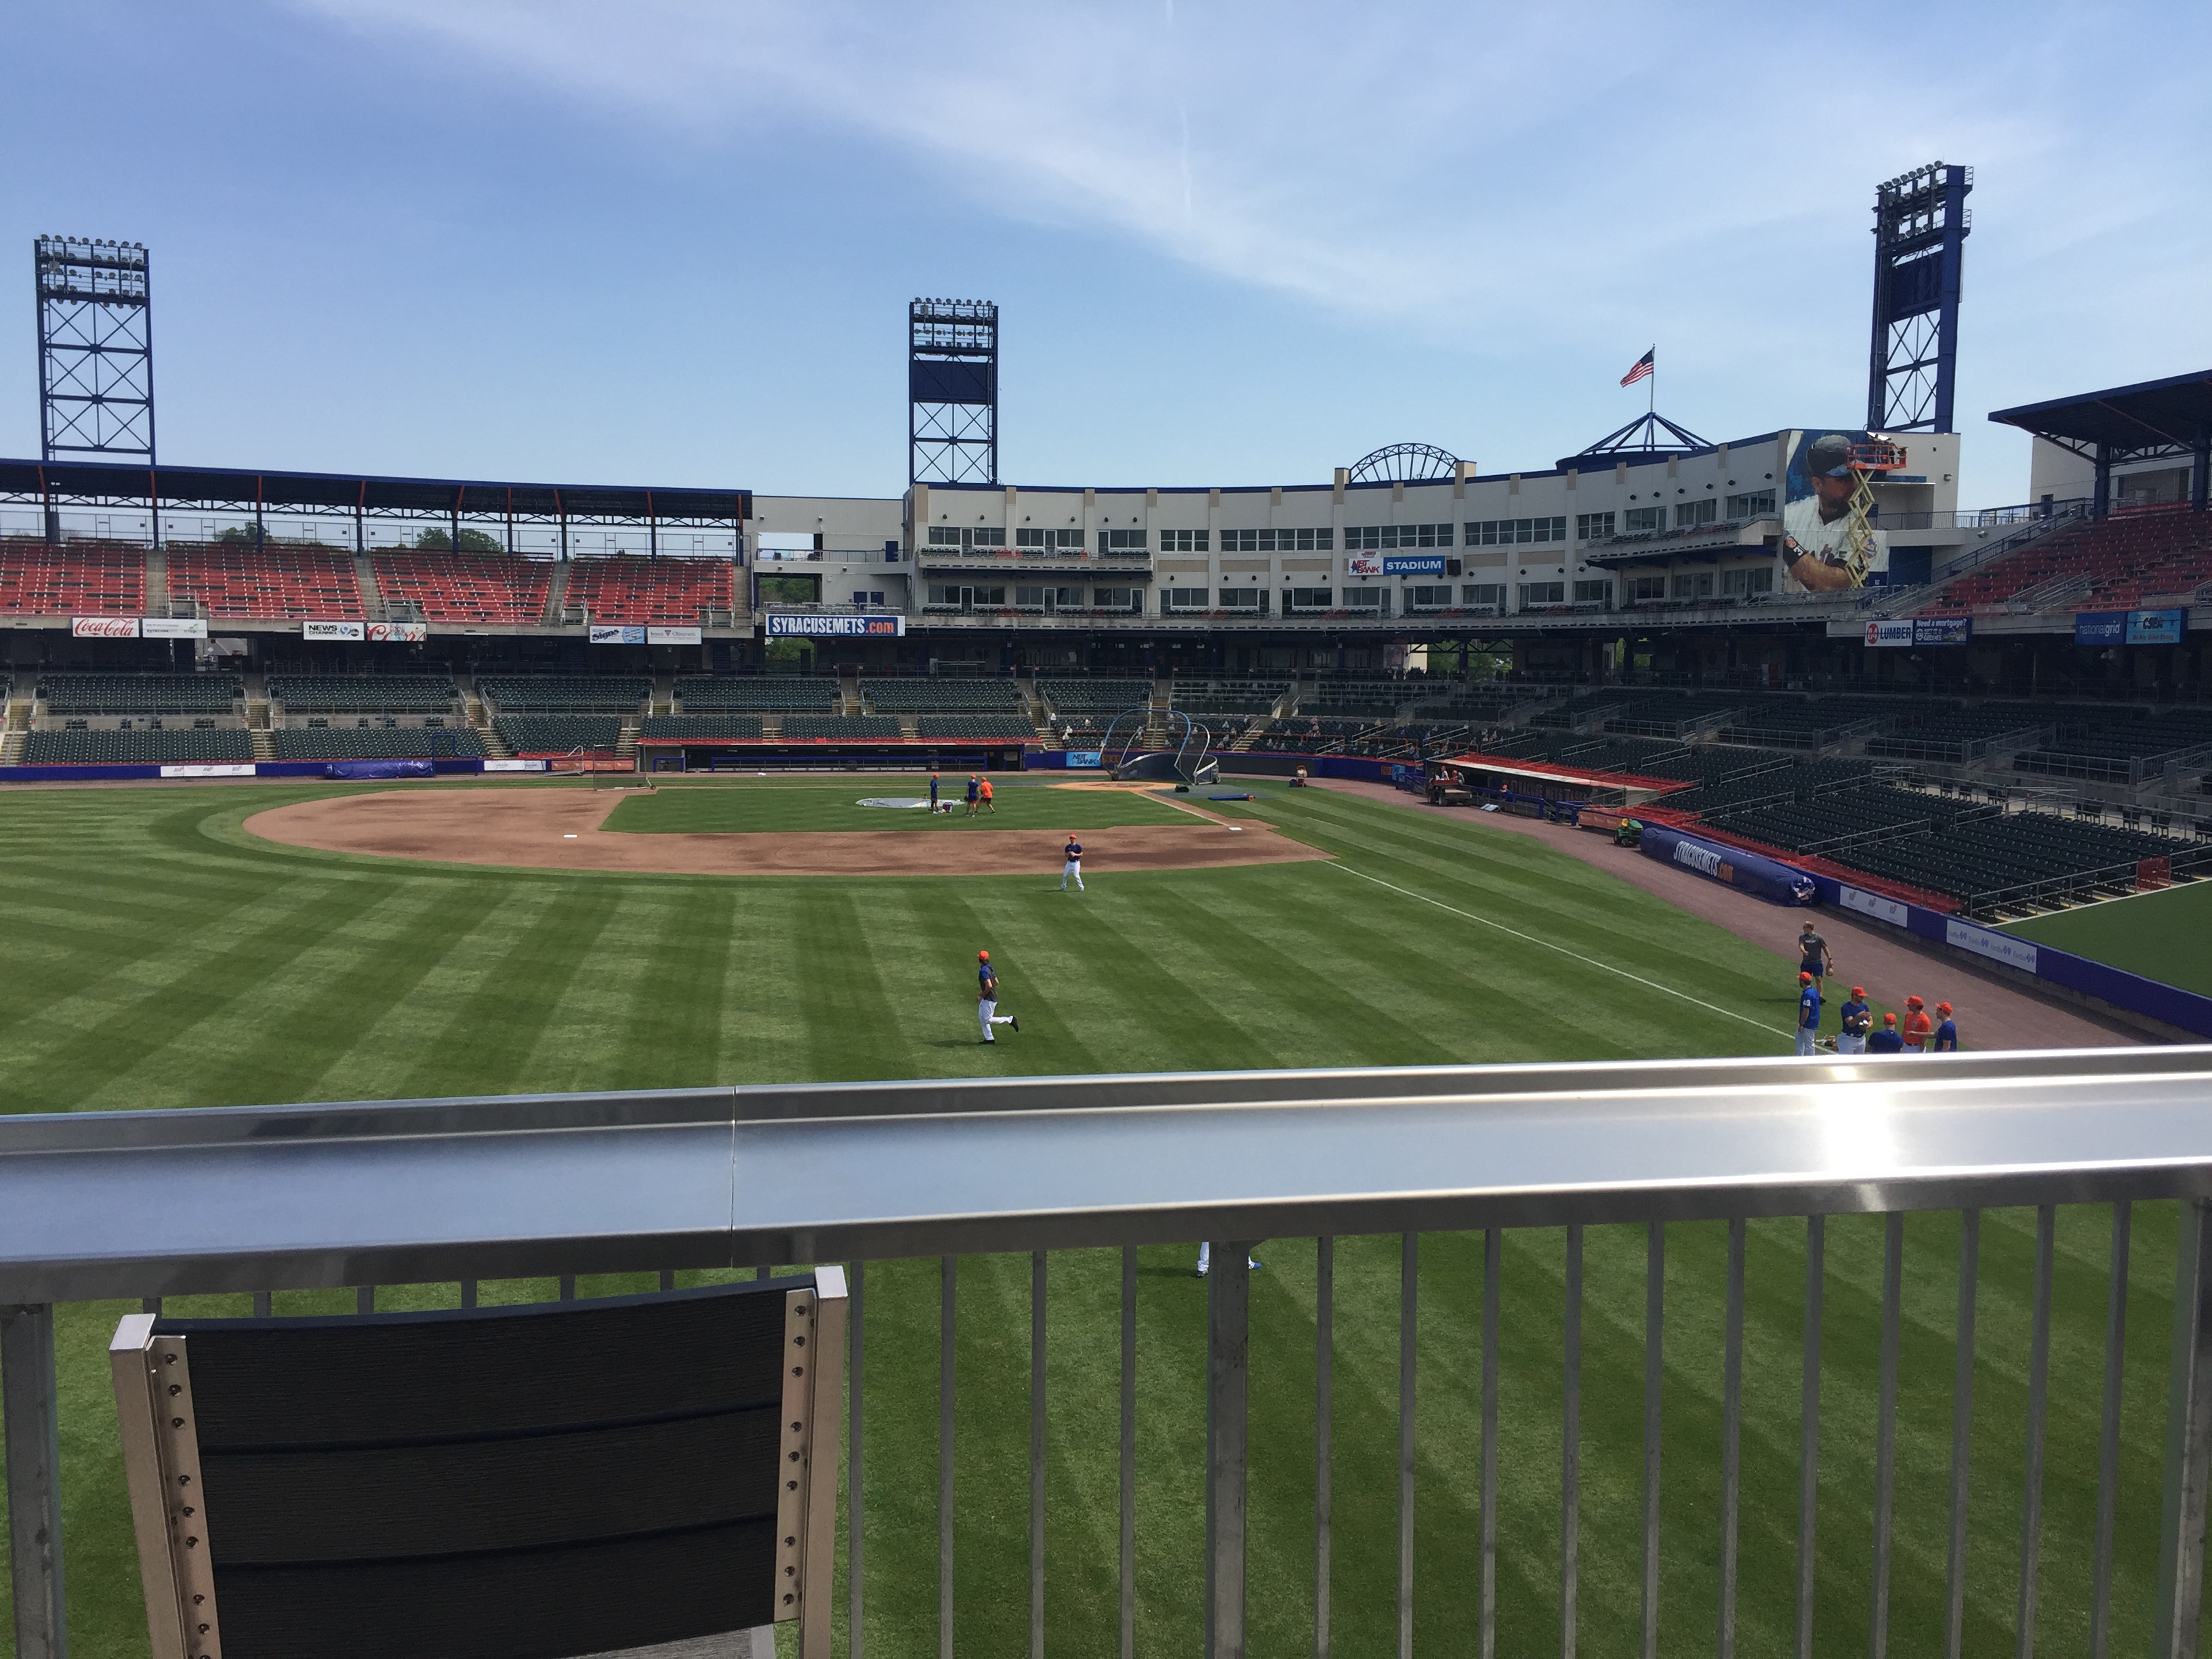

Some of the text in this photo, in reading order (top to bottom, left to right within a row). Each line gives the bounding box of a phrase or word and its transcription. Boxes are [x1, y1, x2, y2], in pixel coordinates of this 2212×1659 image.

[1387, 560, 1441, 570] STADIUM
[75, 618, 136, 636] Coca-Cola
[773, 617, 894, 634] SYRACUSEMETS.com
[1936, 618, 1967, 628] mortgage?
[2079, 620, 2120, 637] nationalgrid
[1868, 627, 1911, 640] 84 LUMBER
